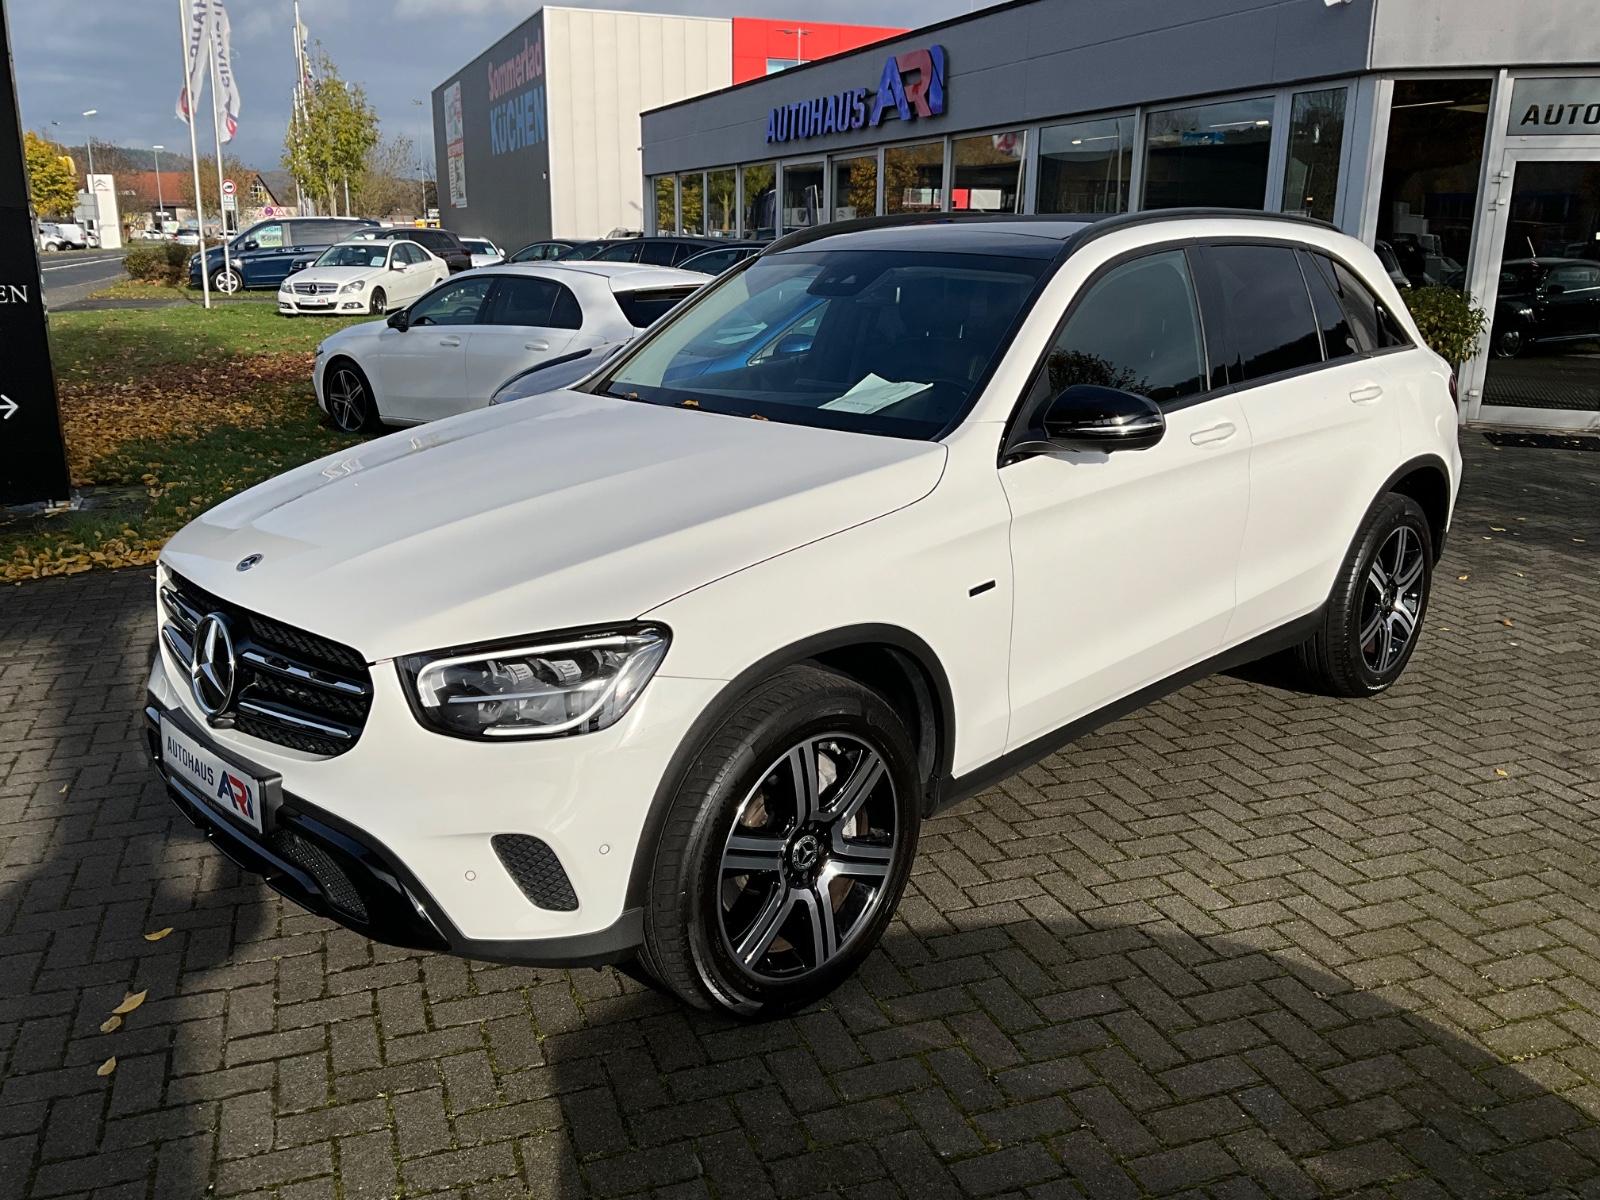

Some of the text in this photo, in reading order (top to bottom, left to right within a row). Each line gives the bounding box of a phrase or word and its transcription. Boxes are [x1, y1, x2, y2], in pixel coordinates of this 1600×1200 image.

[487, 28, 543, 102] Sommerlad
[766, 44, 947, 144] AUTOHAUS ARI
[489, 84, 545, 156] KÜCHEN
[1520, 102, 1600, 126] AUTO
[167, 736, 214, 787] AUTOHAUS
[217, 769, 254, 821] ARI
